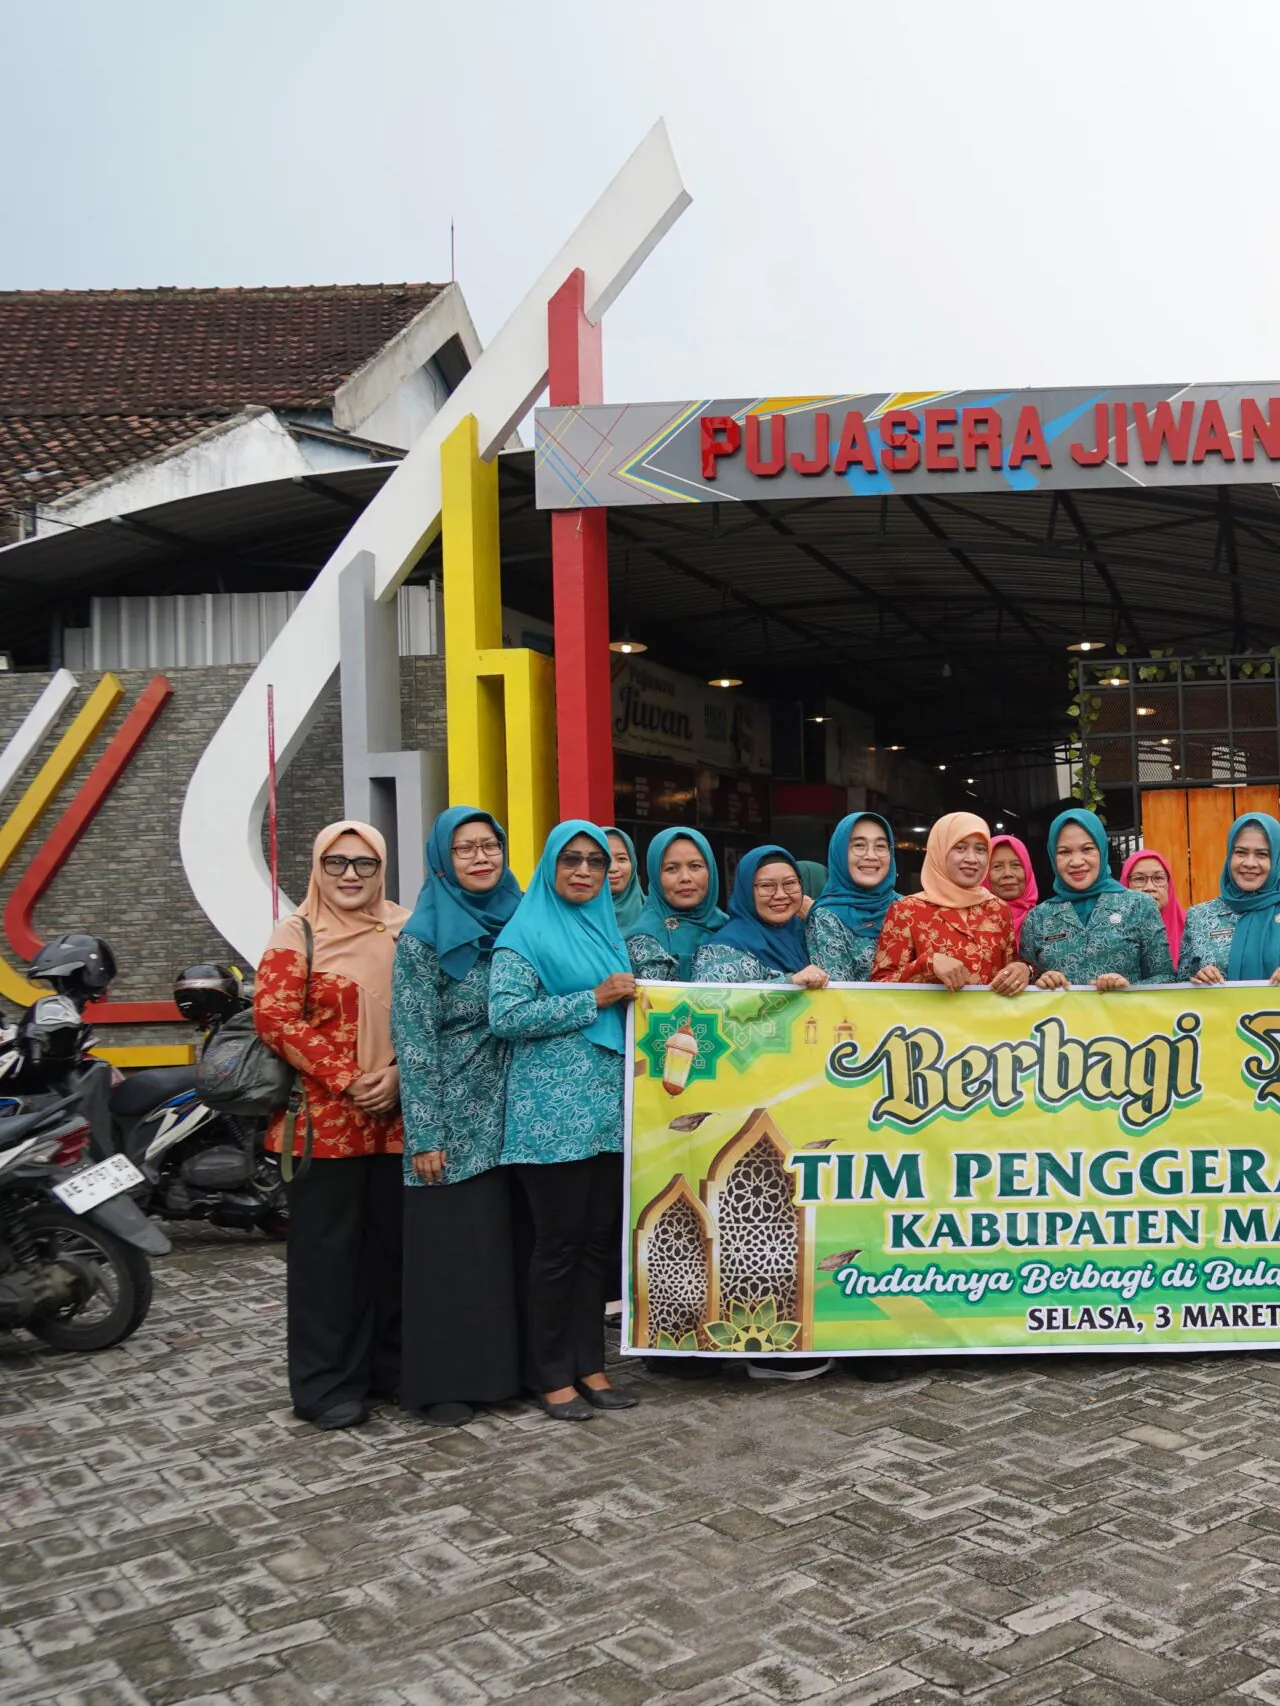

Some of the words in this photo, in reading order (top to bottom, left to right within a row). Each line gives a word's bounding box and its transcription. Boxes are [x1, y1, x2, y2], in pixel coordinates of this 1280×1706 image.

[701, 406, 1052, 480] PUJASERA
[614, 686, 693, 741] Jiwan
[828, 1010, 1204, 1129] Berbagi
[791, 1153, 926, 1202] TIM
[889, 1208, 1201, 1250] KABUPATEN
[836, 1263, 1014, 1301] Indahnya
[1019, 1261, 1155, 1299] Berbagi
[1160, 1261, 1197, 1288] di
[1028, 1306, 1145, 1332] SELASA,
[1154, 1305, 1173, 1329] 3
